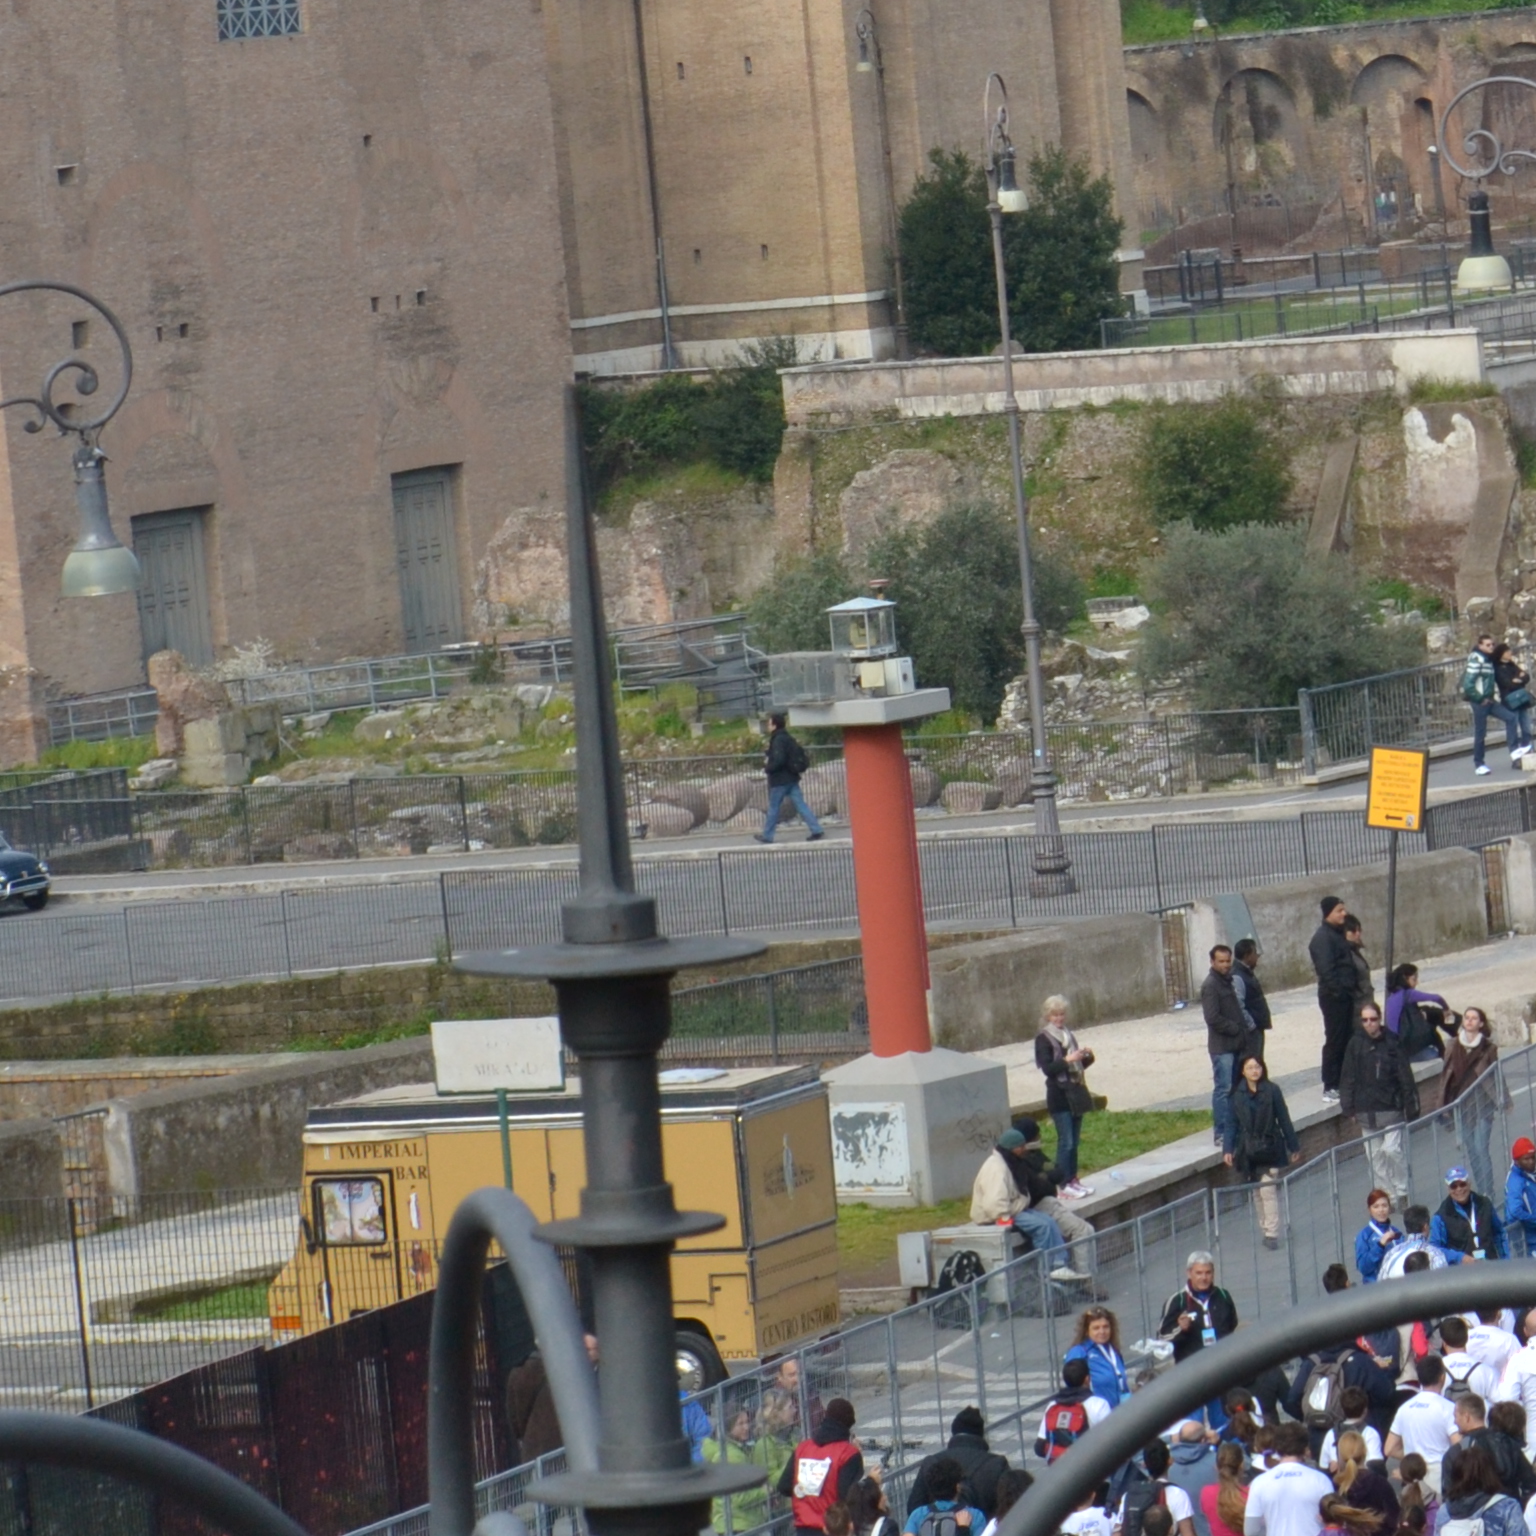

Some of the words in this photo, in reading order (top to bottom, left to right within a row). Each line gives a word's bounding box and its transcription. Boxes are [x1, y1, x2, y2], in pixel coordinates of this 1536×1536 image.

[340, 1143, 423, 1160] IMPERIAL
[396, 1165, 428, 1180] BAR
[763, 1316, 798, 1347] CENTRO
[801, 1302, 837, 1333] RISTORO
